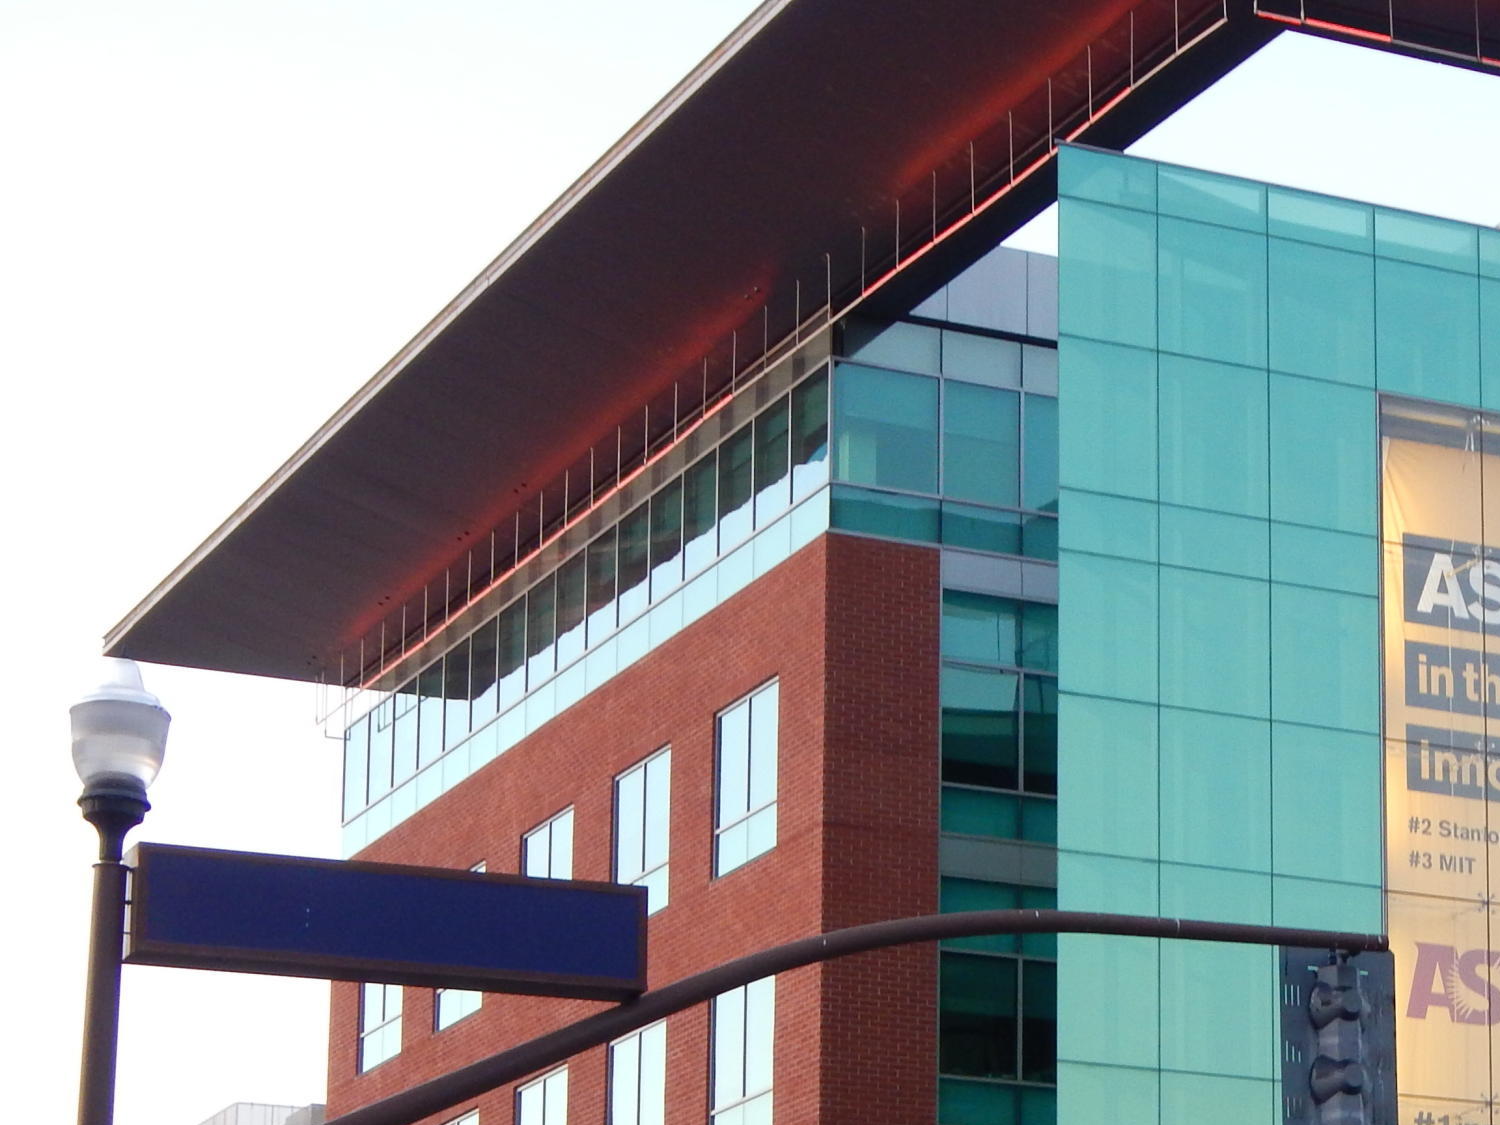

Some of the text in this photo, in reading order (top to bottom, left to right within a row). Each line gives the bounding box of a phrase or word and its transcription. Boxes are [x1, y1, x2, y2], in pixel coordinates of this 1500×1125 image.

[1418, 654, 1454, 698] in
[1408, 816, 1432, 836] #2
[1409, 850, 1476, 875] #3 MIT
